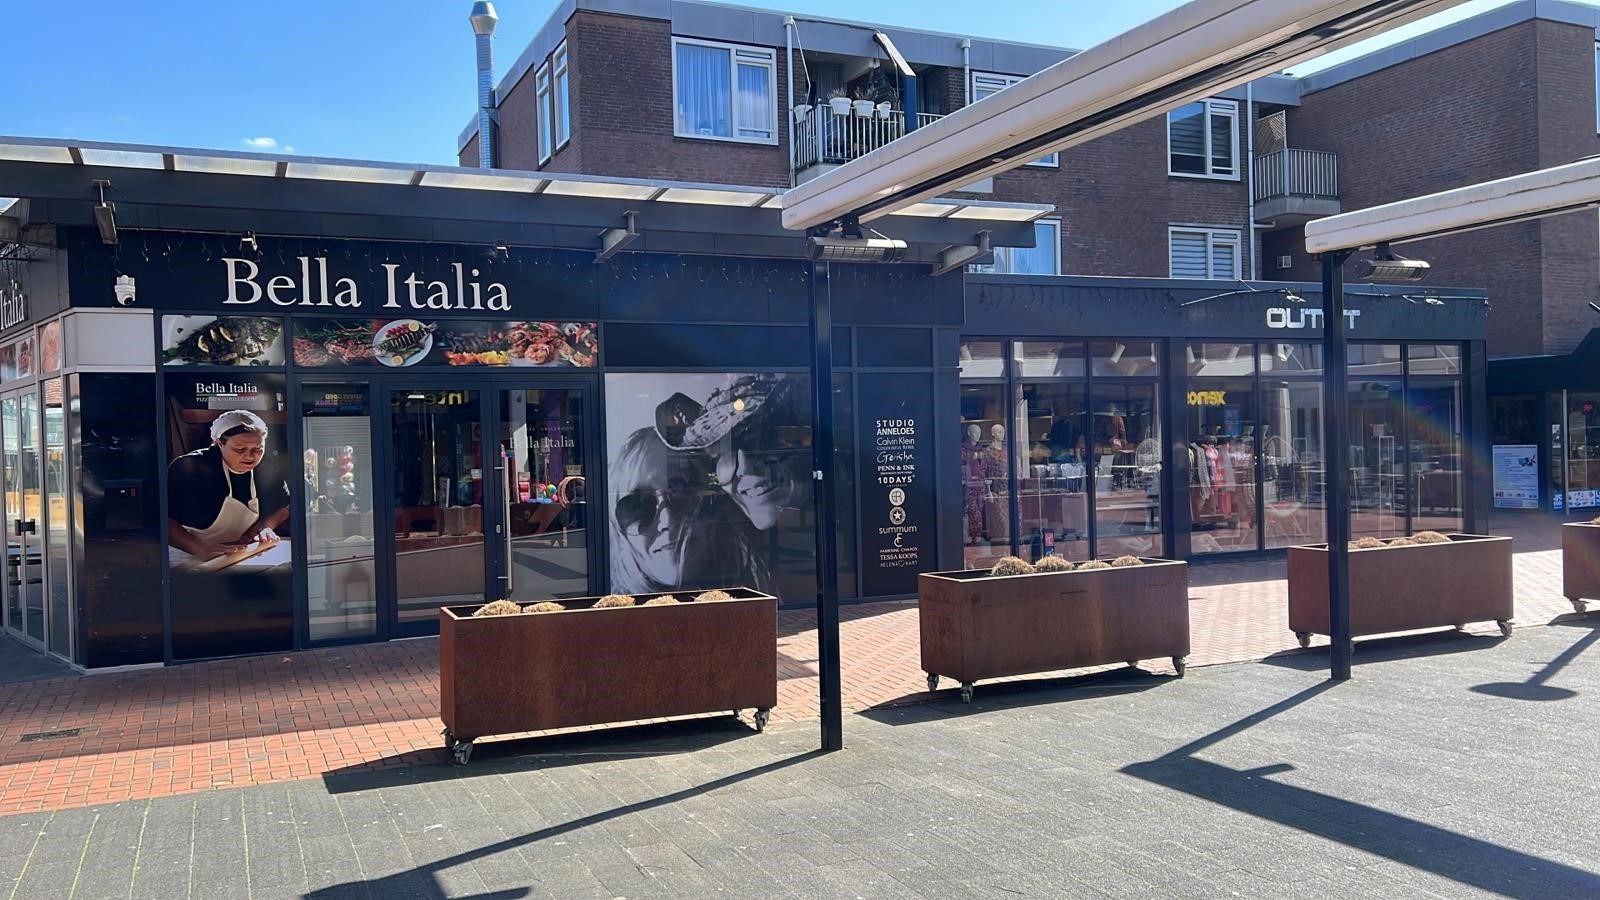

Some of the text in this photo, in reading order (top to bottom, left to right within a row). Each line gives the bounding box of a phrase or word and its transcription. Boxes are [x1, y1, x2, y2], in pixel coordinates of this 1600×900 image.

[221, 256, 512, 312] Bella Italia
[0, 279, 25, 330] Italia
[1266, 307, 1361, 330] OUTT
[195, 382, 257, 393] Bella Italia
[876, 419, 914, 428] STUDIO
[876, 428, 915, 436] ANNELOES
[547, 435, 575, 448] Italia
[876, 437, 915, 446] Calvin Klein
[876, 451, 915, 464] Geisha
[878, 526, 917, 534] summum
